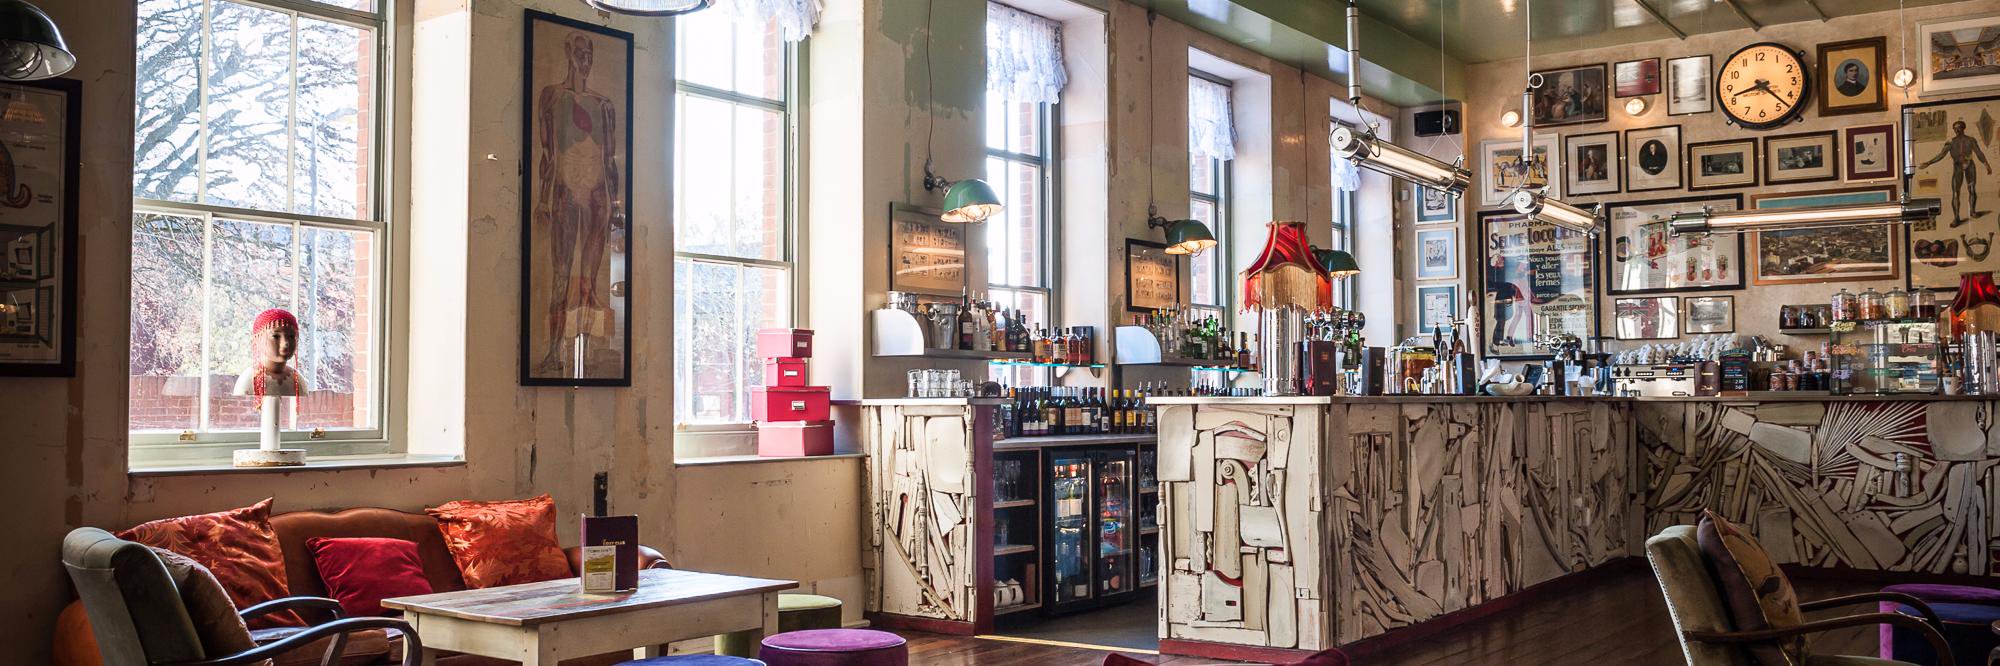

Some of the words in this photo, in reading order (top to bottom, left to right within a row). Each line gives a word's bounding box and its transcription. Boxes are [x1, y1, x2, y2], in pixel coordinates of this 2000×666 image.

[1755, 52, 1765, 62] 12
[1776, 55, 1778, 63] 1
[1742, 58, 1747, 67] 11
[1786, 64, 1793, 73] 2
[1731, 71, 1739, 79] 10
[1791, 77, 1797, 85] 3
[1745, 107, 1750, 115] 7
